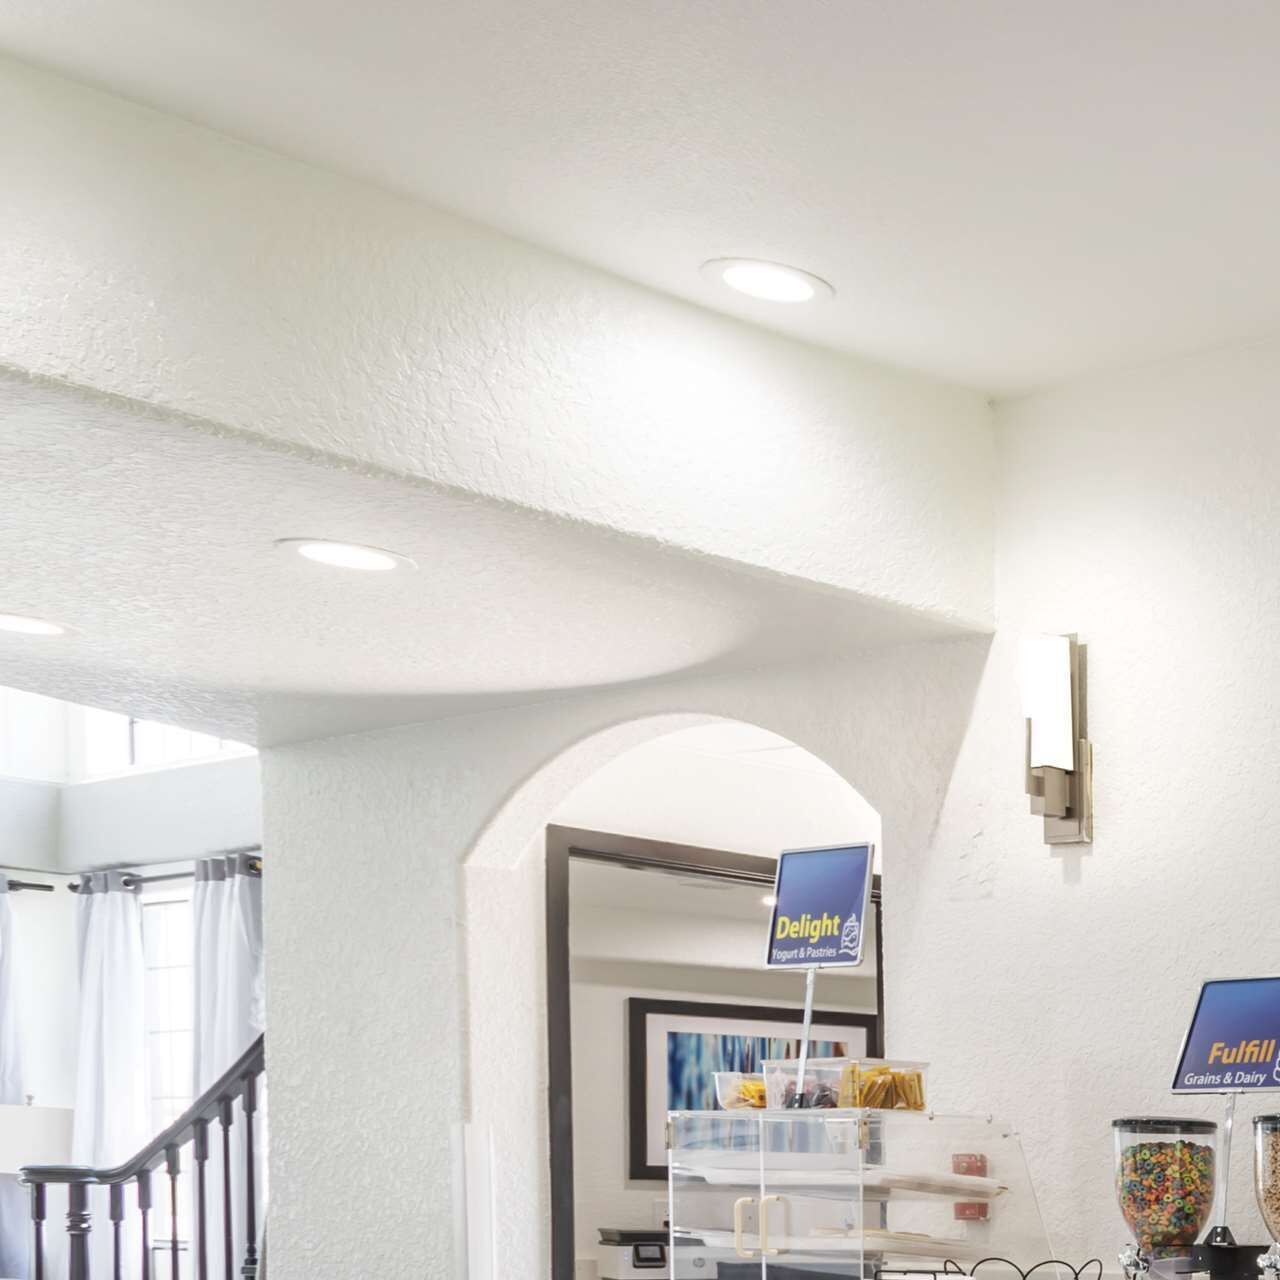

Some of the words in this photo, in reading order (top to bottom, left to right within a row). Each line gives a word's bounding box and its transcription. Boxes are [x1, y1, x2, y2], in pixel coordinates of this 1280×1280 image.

[776, 912, 840, 943] Delight
[773, 949, 798, 961] Yogurt
[799, 948, 806, 958] &
[806, 946, 837, 957] Pastries
[1208, 1039, 1276, 1064] Fulfill
[1184, 1072, 1222, 1085] Grains
[1223, 1072, 1233, 1083] &
[1235, 1071, 1267, 1086] Dairy
